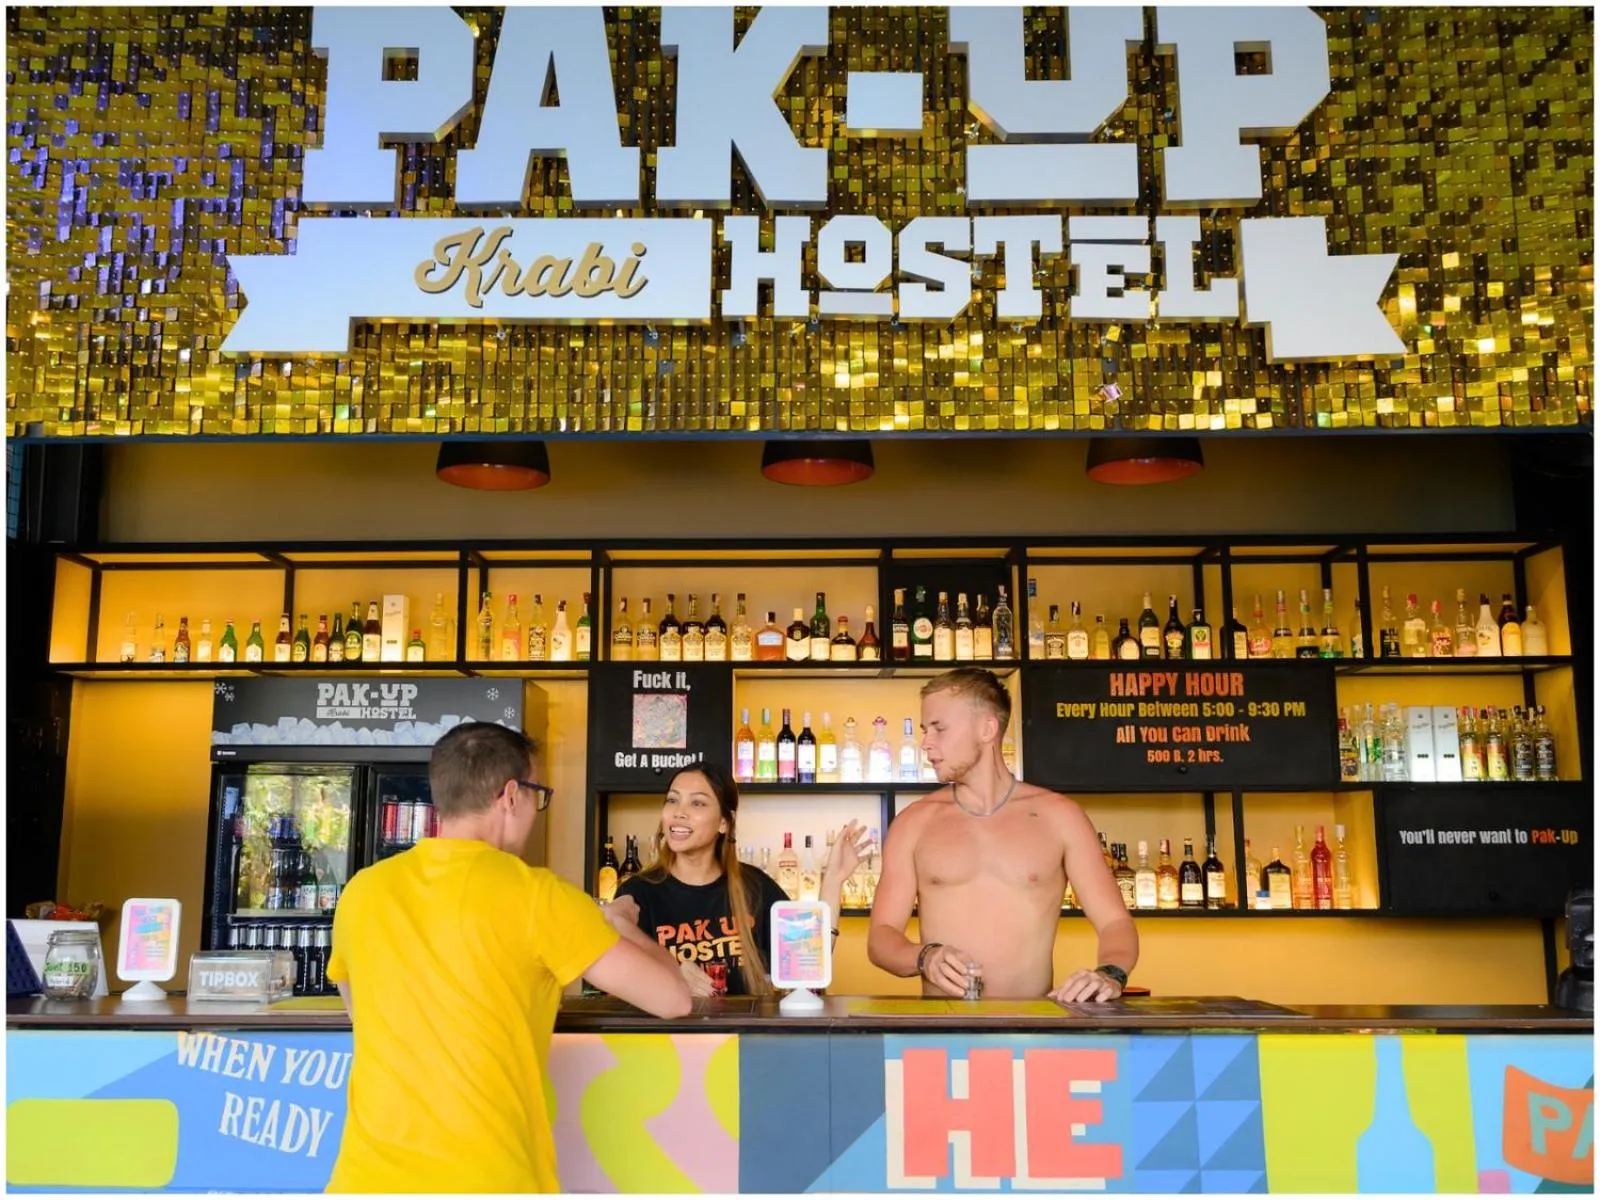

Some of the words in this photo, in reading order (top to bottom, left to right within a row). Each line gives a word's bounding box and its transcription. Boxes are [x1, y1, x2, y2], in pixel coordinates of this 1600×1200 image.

[303, 6, 1331, 207] PAK-UP
[414, 226, 649, 307] Krabi
[722, 215, 1239, 319] HOSTEL
[632, 670, 672, 689] Fuck
[675, 671, 691, 691] it,
[1110, 672, 1178, 697] HAPPY
[1185, 672, 1244, 697] HOUR
[316, 683, 418, 706] PAK-UP
[361, 707, 417, 719] HOSTEL
[1056, 703, 1096, 719] Every
[1100, 703, 1135, 717] Hour
[1138, 703, 1199, 717] Between
[1202, 702, 1234, 717] 5:00
[1247, 702, 1280, 717] 9:30
[1284, 702, 1306, 716] PM
[1116, 725, 1136, 743] All
[1140, 726, 1168, 743] You
[1171, 725, 1201, 743] Can
[1206, 723, 1251, 742] Drink
[615, 752, 637, 768] Get
[640, 753, 649, 768] A
[1147, 750, 1171, 763] 500
[1187, 750, 1196, 762] 2
[1198, 749, 1224, 763] hrs.
[1399, 829, 1435, 844] You'll
[1438, 830, 1477, 844] never
[1479, 829, 1513, 844] want
[1514, 829, 1529, 844] to
[1531, 828, 1579, 845] Pak-Up
[655, 918, 714, 946] PAK
[200, 971, 259, 988] TIPBOX
[177, 1031, 276, 1083] WHEN
[280, 1047, 352, 1089] YOU
[218, 1091, 334, 1158] READY
[885, 1048, 1122, 1189] HE
